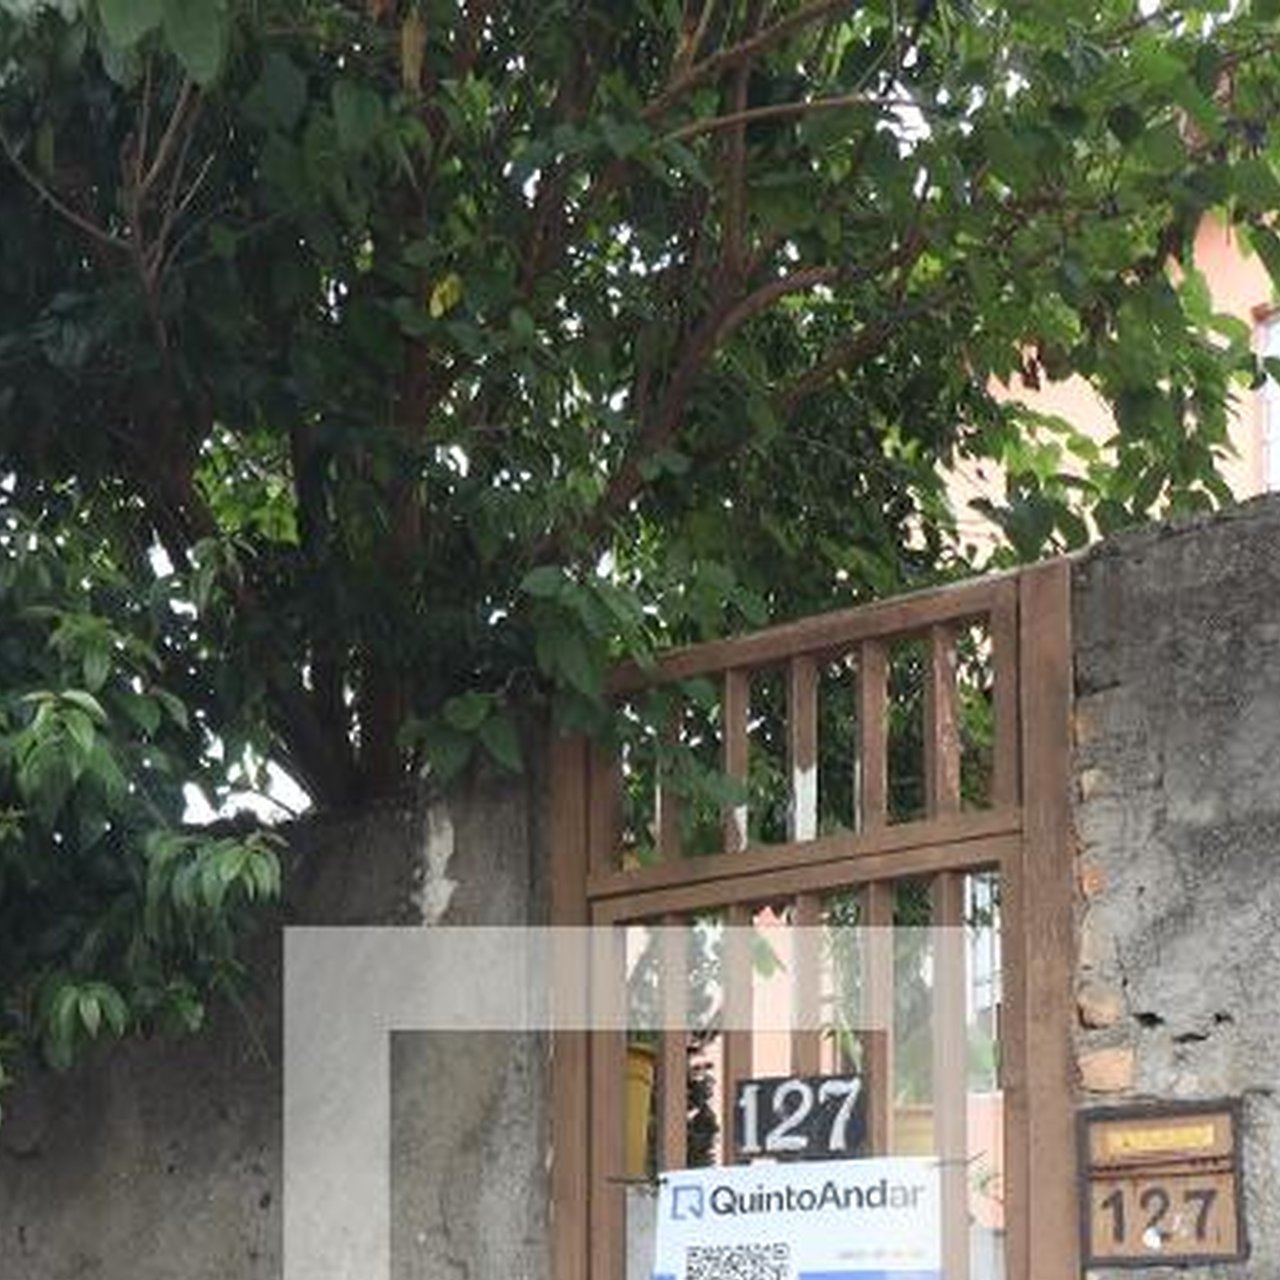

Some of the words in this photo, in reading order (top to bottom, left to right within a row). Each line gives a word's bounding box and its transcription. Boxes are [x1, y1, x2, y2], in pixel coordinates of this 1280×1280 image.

[739, 1077, 861, 1152] 127
[710, 1179, 925, 1216] QuintoAndar
[1101, 1187, 1217, 1247] 127
